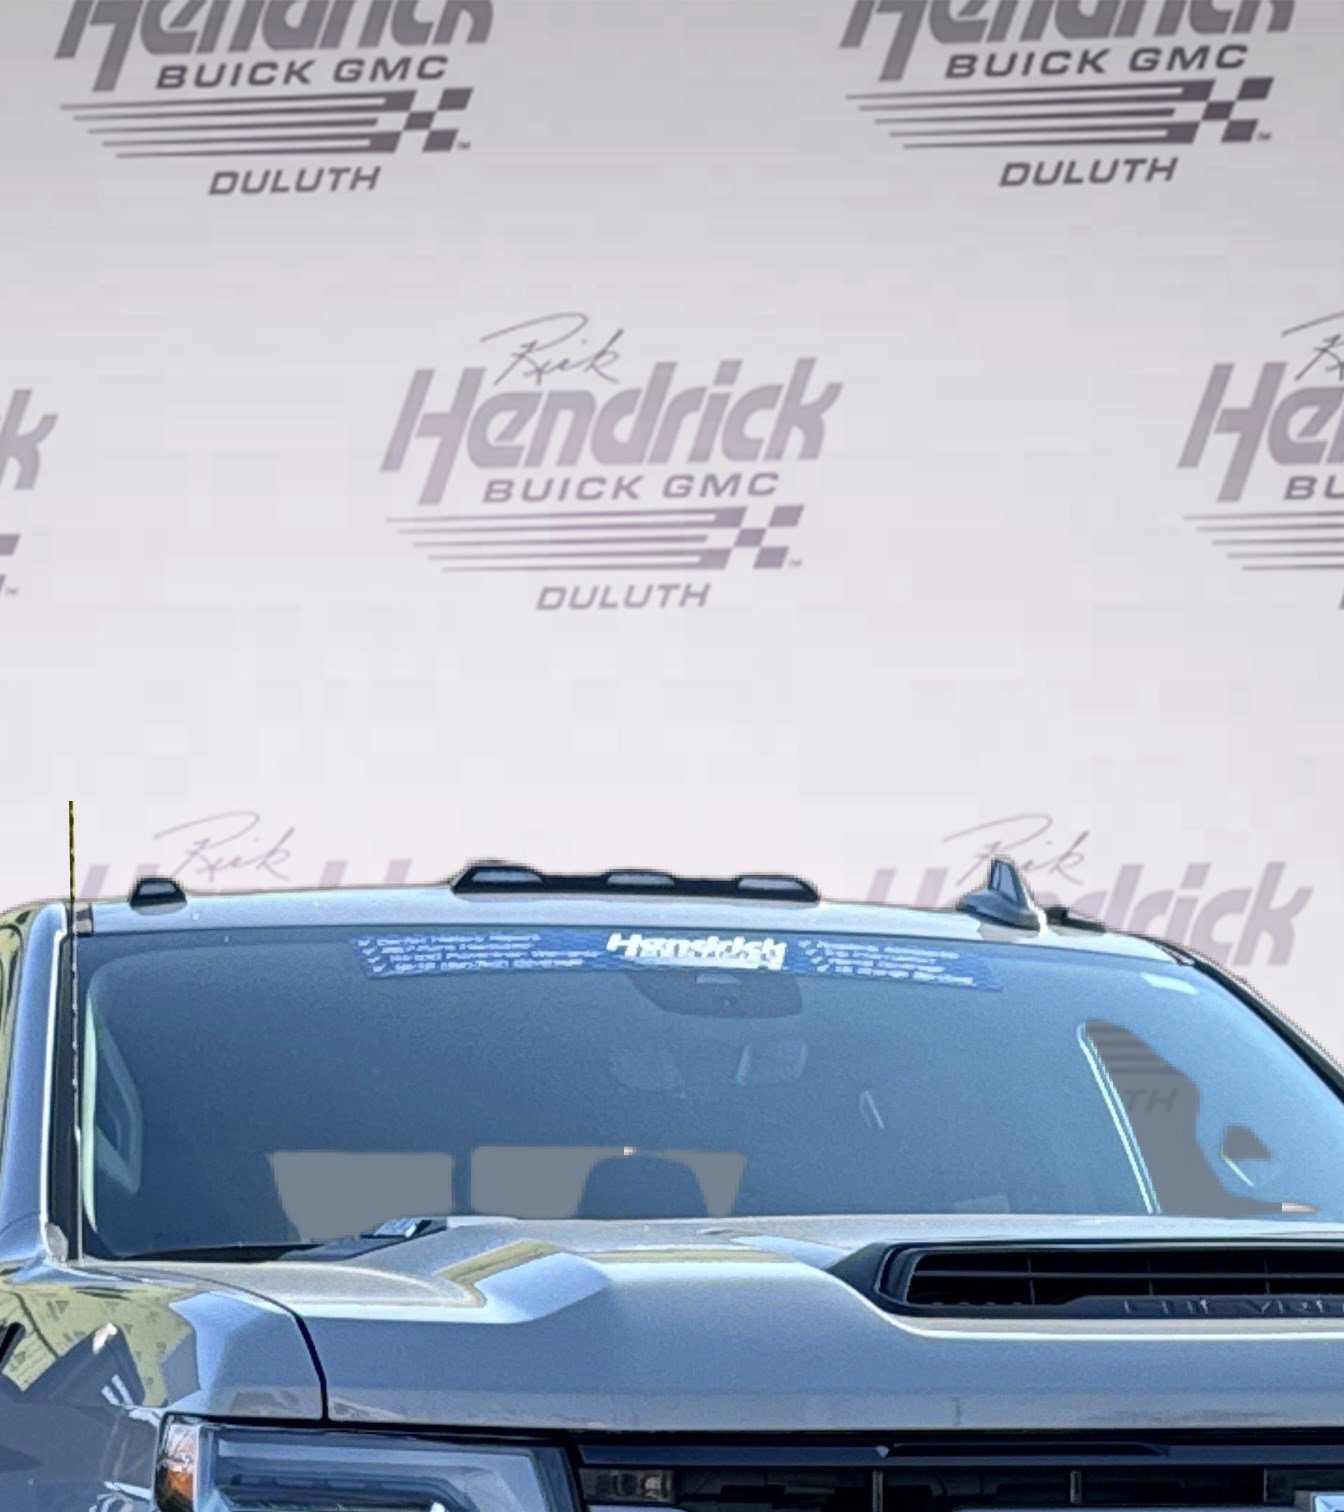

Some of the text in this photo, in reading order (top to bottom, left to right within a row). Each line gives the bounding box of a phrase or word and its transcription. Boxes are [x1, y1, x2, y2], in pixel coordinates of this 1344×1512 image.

[156, 55, 449, 90] BUICK GMC
[944, 44, 1249, 80] BUICK GMC
[207, 166, 382, 196] DULUTH
[998, 157, 1180, 188] DULUTH
[379, 357, 844, 507] Hendrick
[482, 472, 780, 504] BUICK GMC
[535, 582, 712, 611] DULUTH
